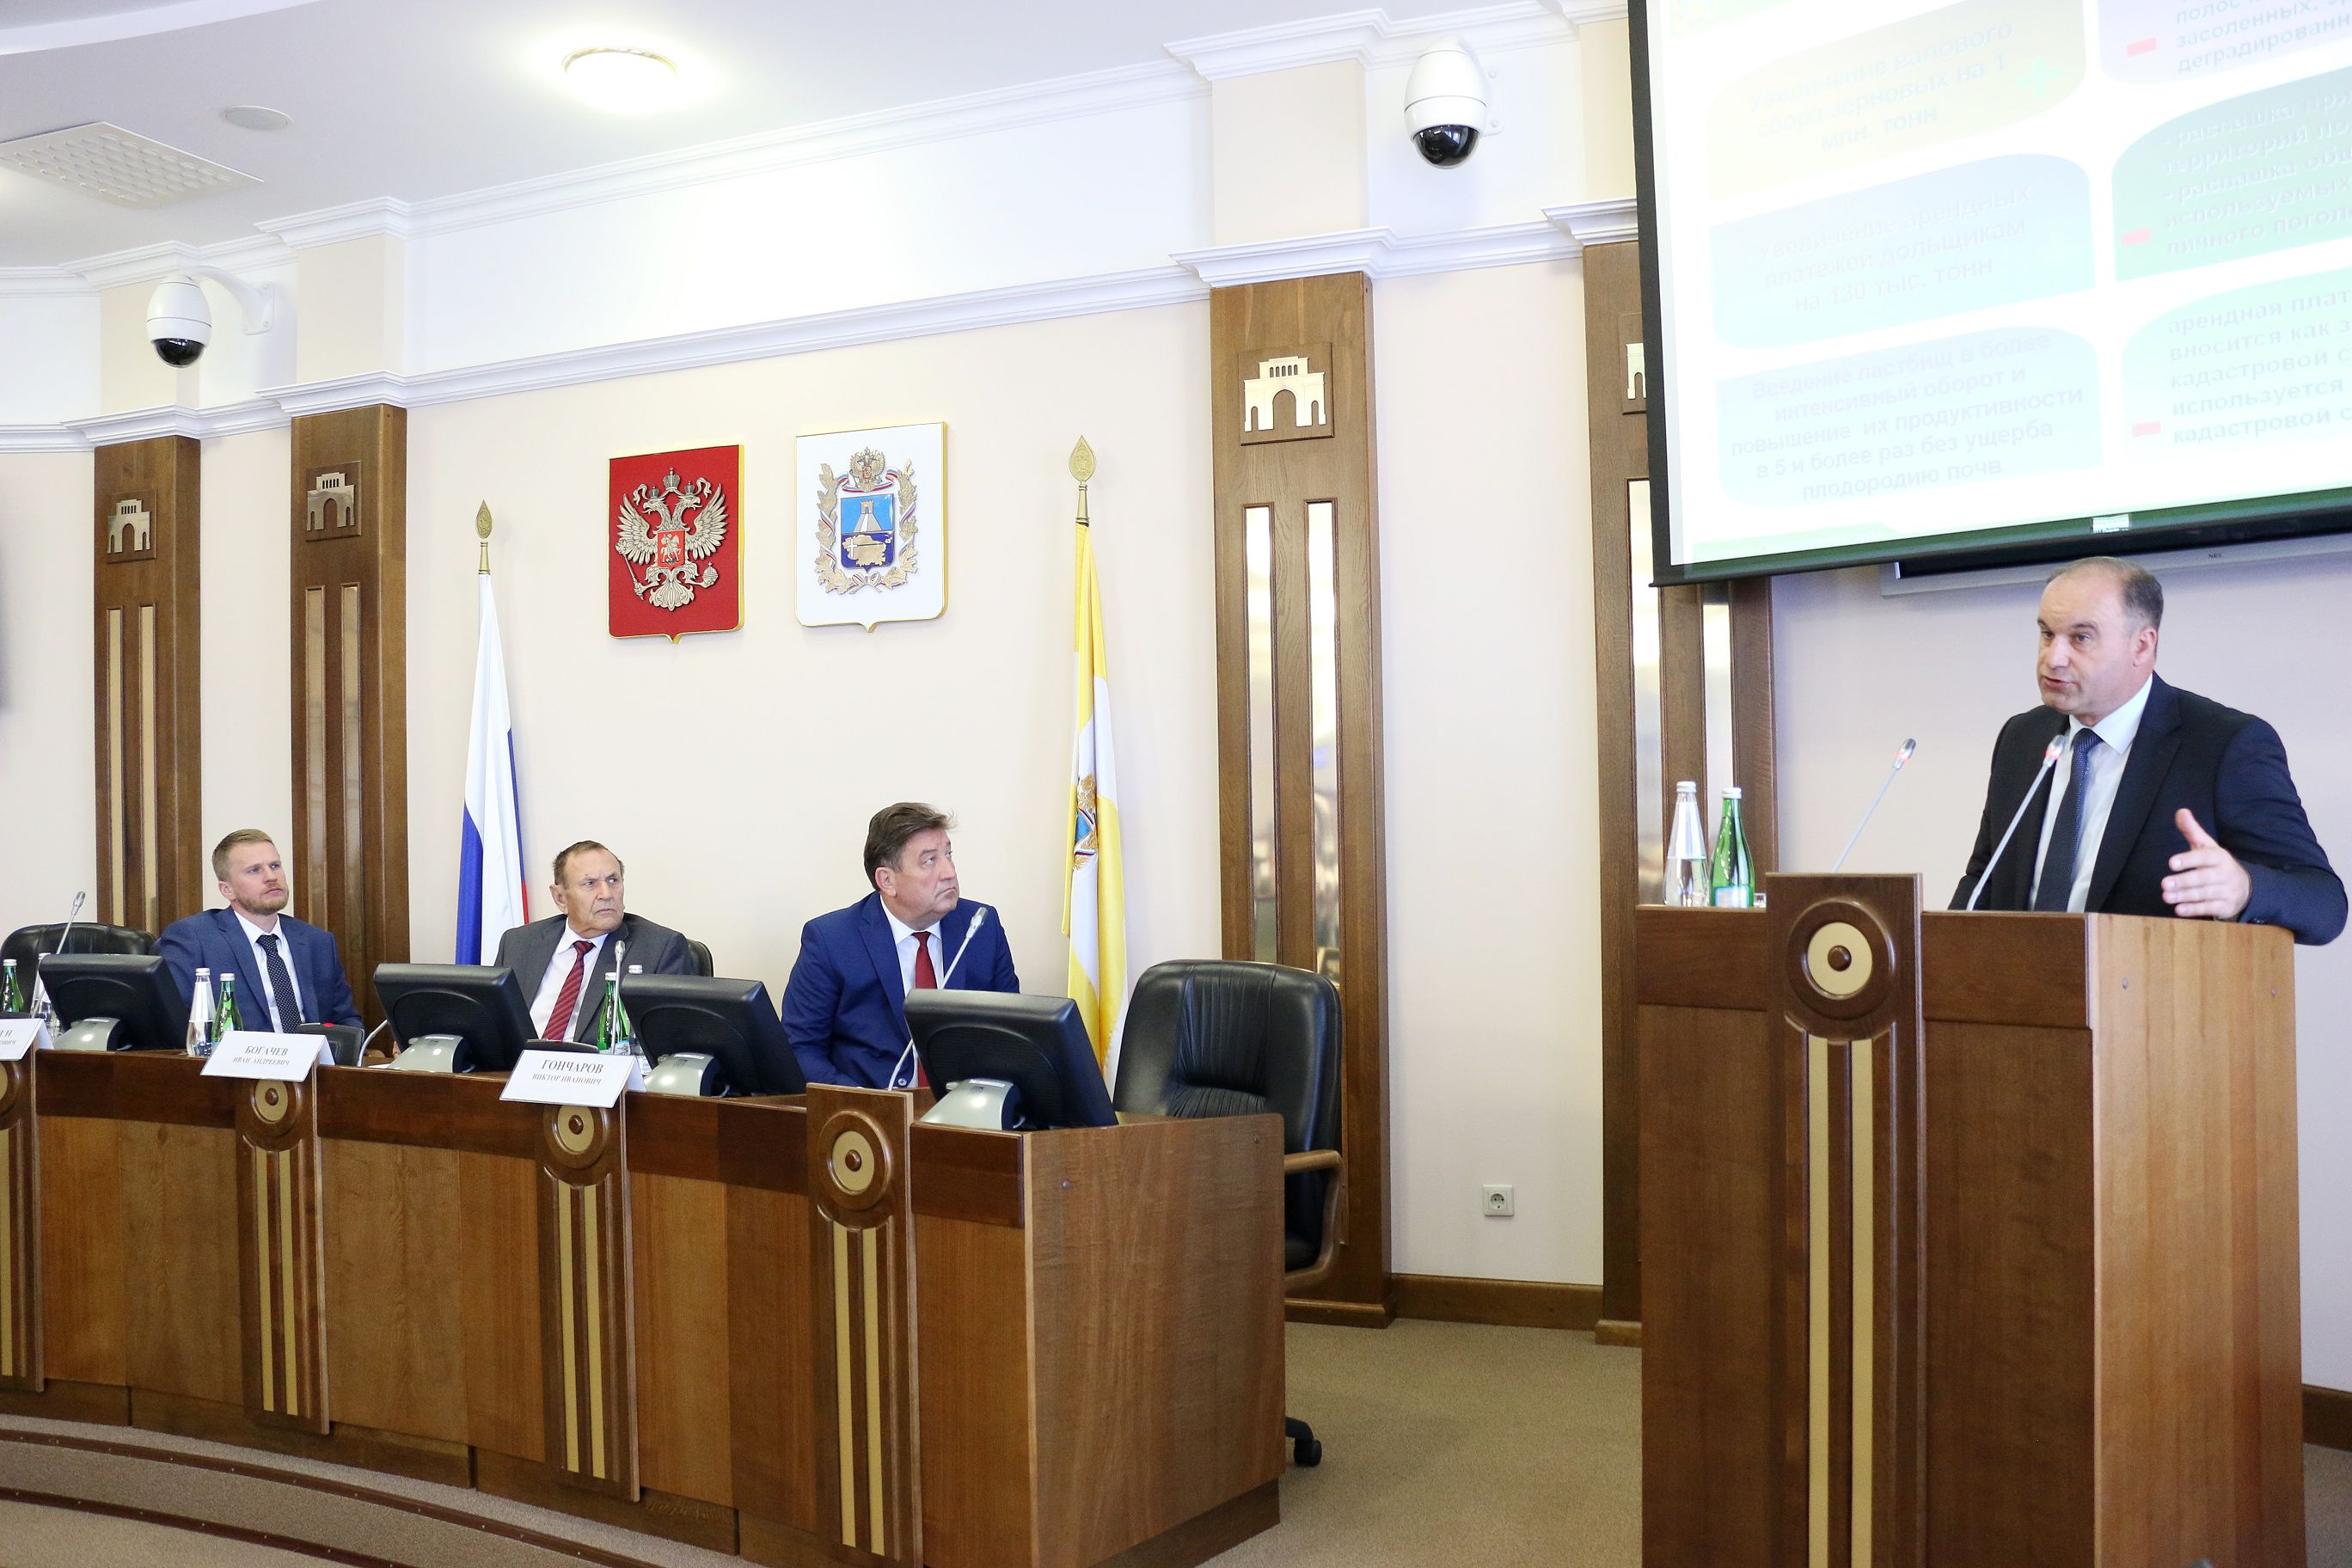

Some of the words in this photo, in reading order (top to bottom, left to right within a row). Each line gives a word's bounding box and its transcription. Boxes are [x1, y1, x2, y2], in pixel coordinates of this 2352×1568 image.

[1895, 21, 2013, 71] валового
[1957, 62, 1986, 83] на
[1881, 106, 1938, 136] тонн
[2179, 161, 2297, 206] распашка
[1760, 217, 1897, 261] Увеличение
[1904, 185, 2033, 231] арендных
[2166, 225, 2264, 255] личного
[1764, 250, 1874, 291] платежей
[1880, 218, 2028, 269] дольщикам
[1795, 294, 1821, 314] на
[1831, 281, 1866, 306] 130
[1873, 273, 1926, 298] тыс.
[1933, 257, 1994, 285] тонн
[2168, 302, 2283, 337] арендная
[2170, 330, 2282, 361] вносится
[2290, 322, 2331, 343] как
[1753, 370, 1853, 401] Введение
[1858, 351, 1955, 382] пастбищ
[1960, 347, 1975, 364] в
[1981, 333, 2050, 360] более
[2171, 348, 2328, 389] кадастровой
[1775, 383, 1917, 423] интенсивный
[1924, 372, 2004, 398] оборот
[2012, 366, 2027, 383] и
[2173, 378, 2344, 417] используется
[1731, 424, 1852, 457] повышение
[1864, 419, 1889, 437] их
[1896, 387, 2084, 433] продуктивности
[2173, 407, 2331, 444] кадастровой
[1756, 464, 1769, 481] в
[1775, 456, 1787, 476] 5
[1792, 457, 1805, 475] и
[1810, 447, 1872, 472] более
[1878, 444, 1915, 467] раз
[1920, 435, 1959, 456] без
[1965, 420, 2055, 454] ущерба
[1803, 468, 1940, 501] плодородию
[1946, 458, 2003, 481] почв
[245, 1045, 289, 1057] БОГАЧЕВ
[542, 1059, 603, 1074] ГОНЧАРОВ
[531, 1073, 560, 1082] ВИКТОР
[560, 1075, 603, 1085] ИВАНОВИЧ
